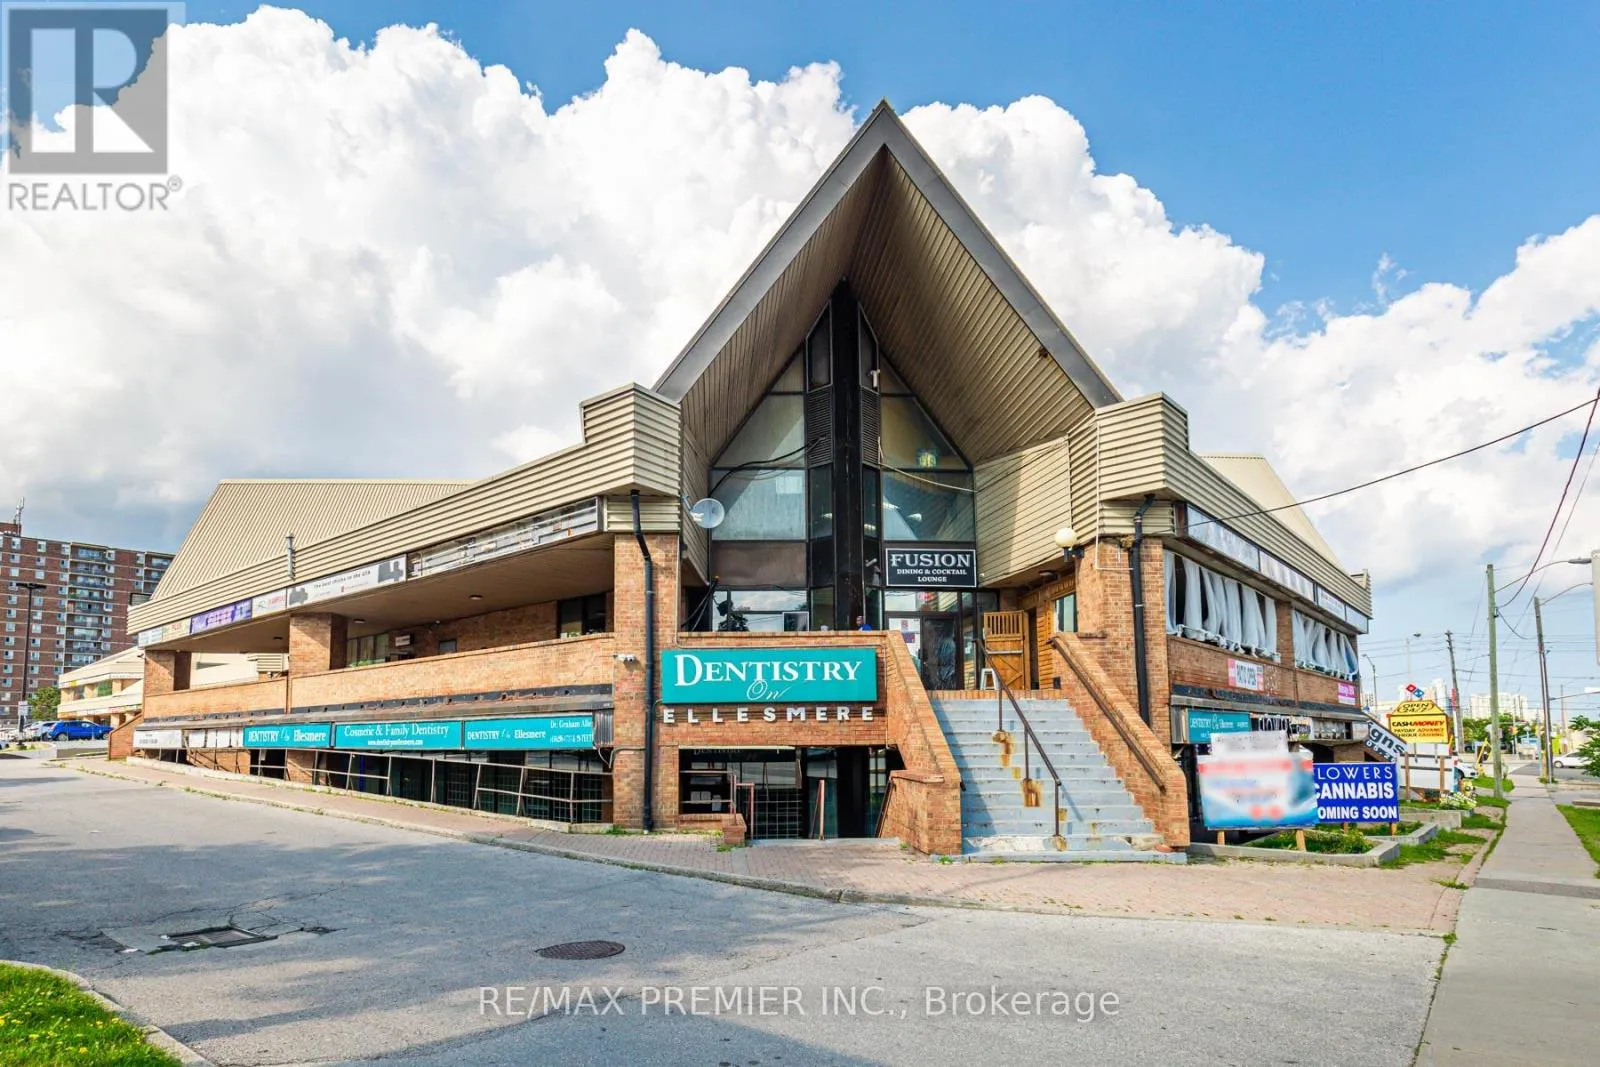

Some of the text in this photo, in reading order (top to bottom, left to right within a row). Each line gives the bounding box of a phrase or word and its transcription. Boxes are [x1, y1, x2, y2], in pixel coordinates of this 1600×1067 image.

[890, 553, 971, 567] FUSION
[674, 654, 862, 686] DENTISTRY
[746, 678, 791, 701] On
[663, 706, 874, 724] ELLESMERE
[1313, 766, 1393, 780] LOWERS
[1362, 806, 1398, 819] SOON
